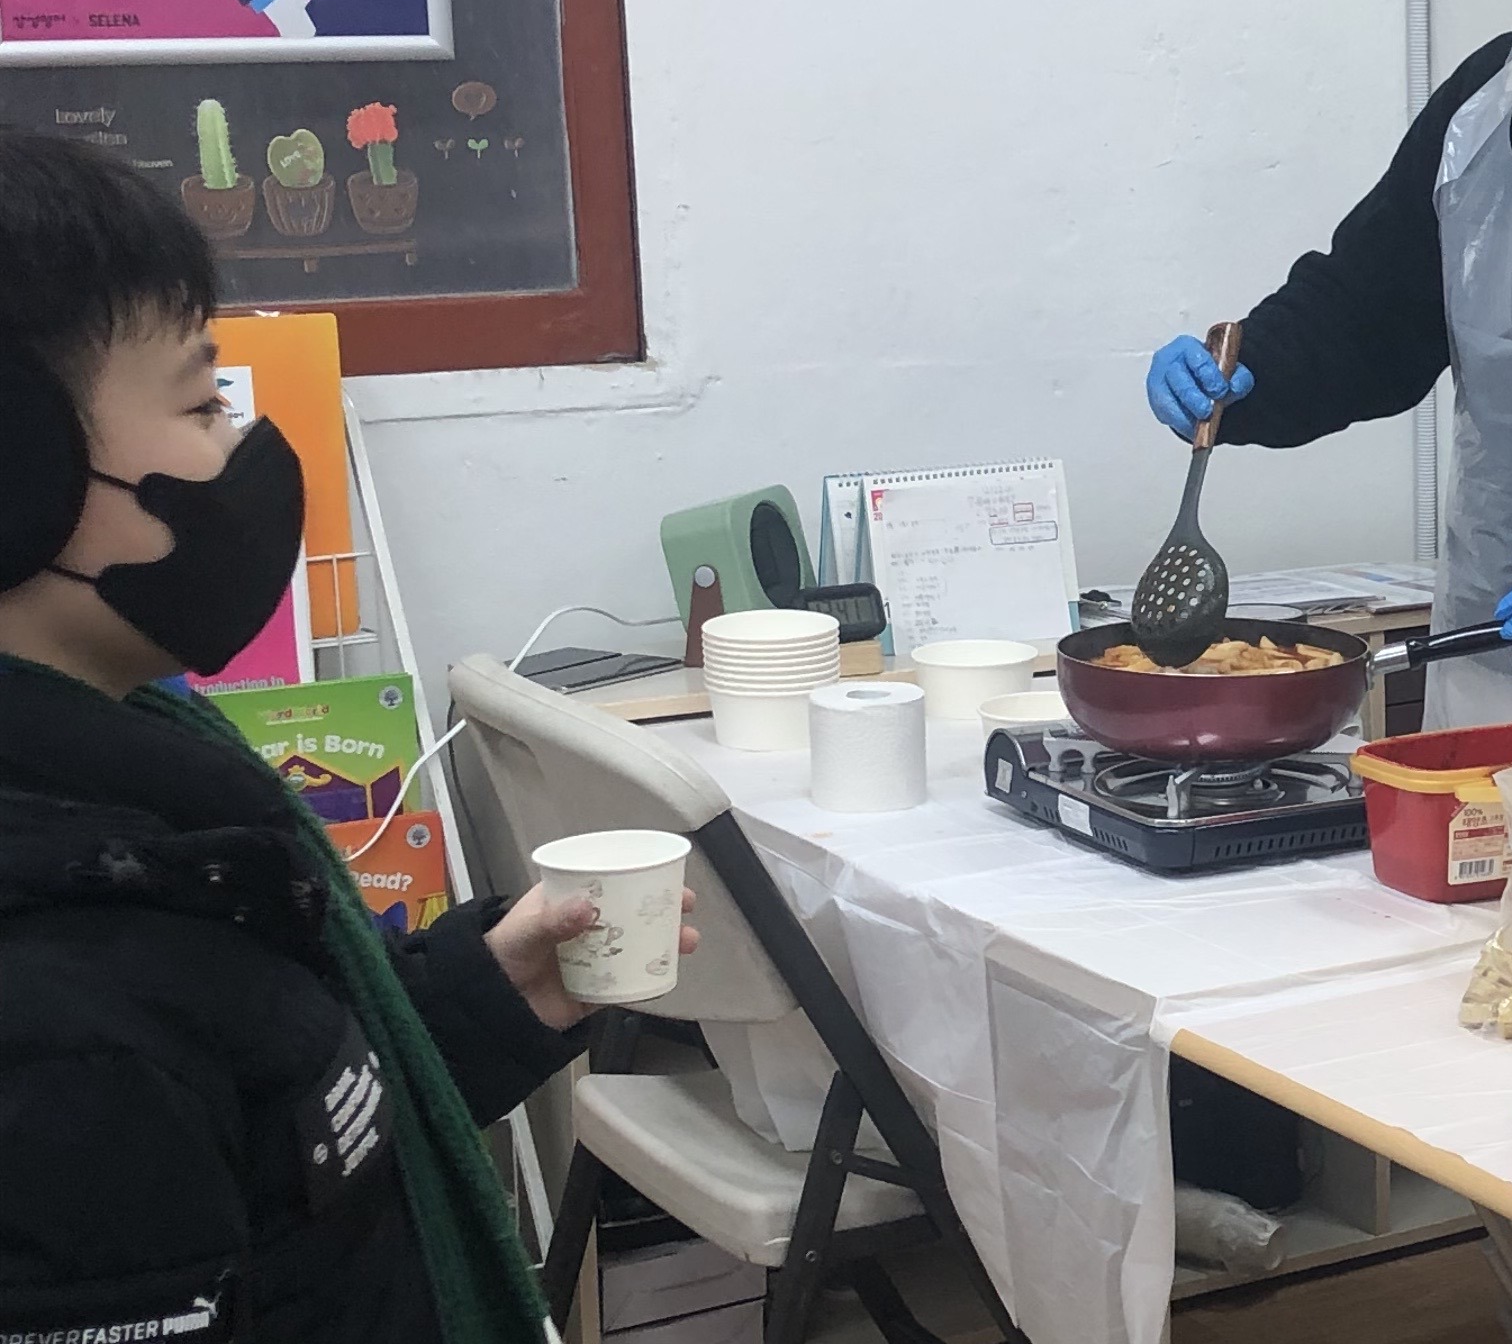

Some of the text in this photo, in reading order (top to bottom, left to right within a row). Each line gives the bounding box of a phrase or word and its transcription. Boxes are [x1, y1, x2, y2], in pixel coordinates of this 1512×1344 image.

[88, 14, 141, 27] SELENA
[55, 106, 117, 128] Lovely
[296, 733, 318, 754] is
[324, 734, 385, 759] Born
